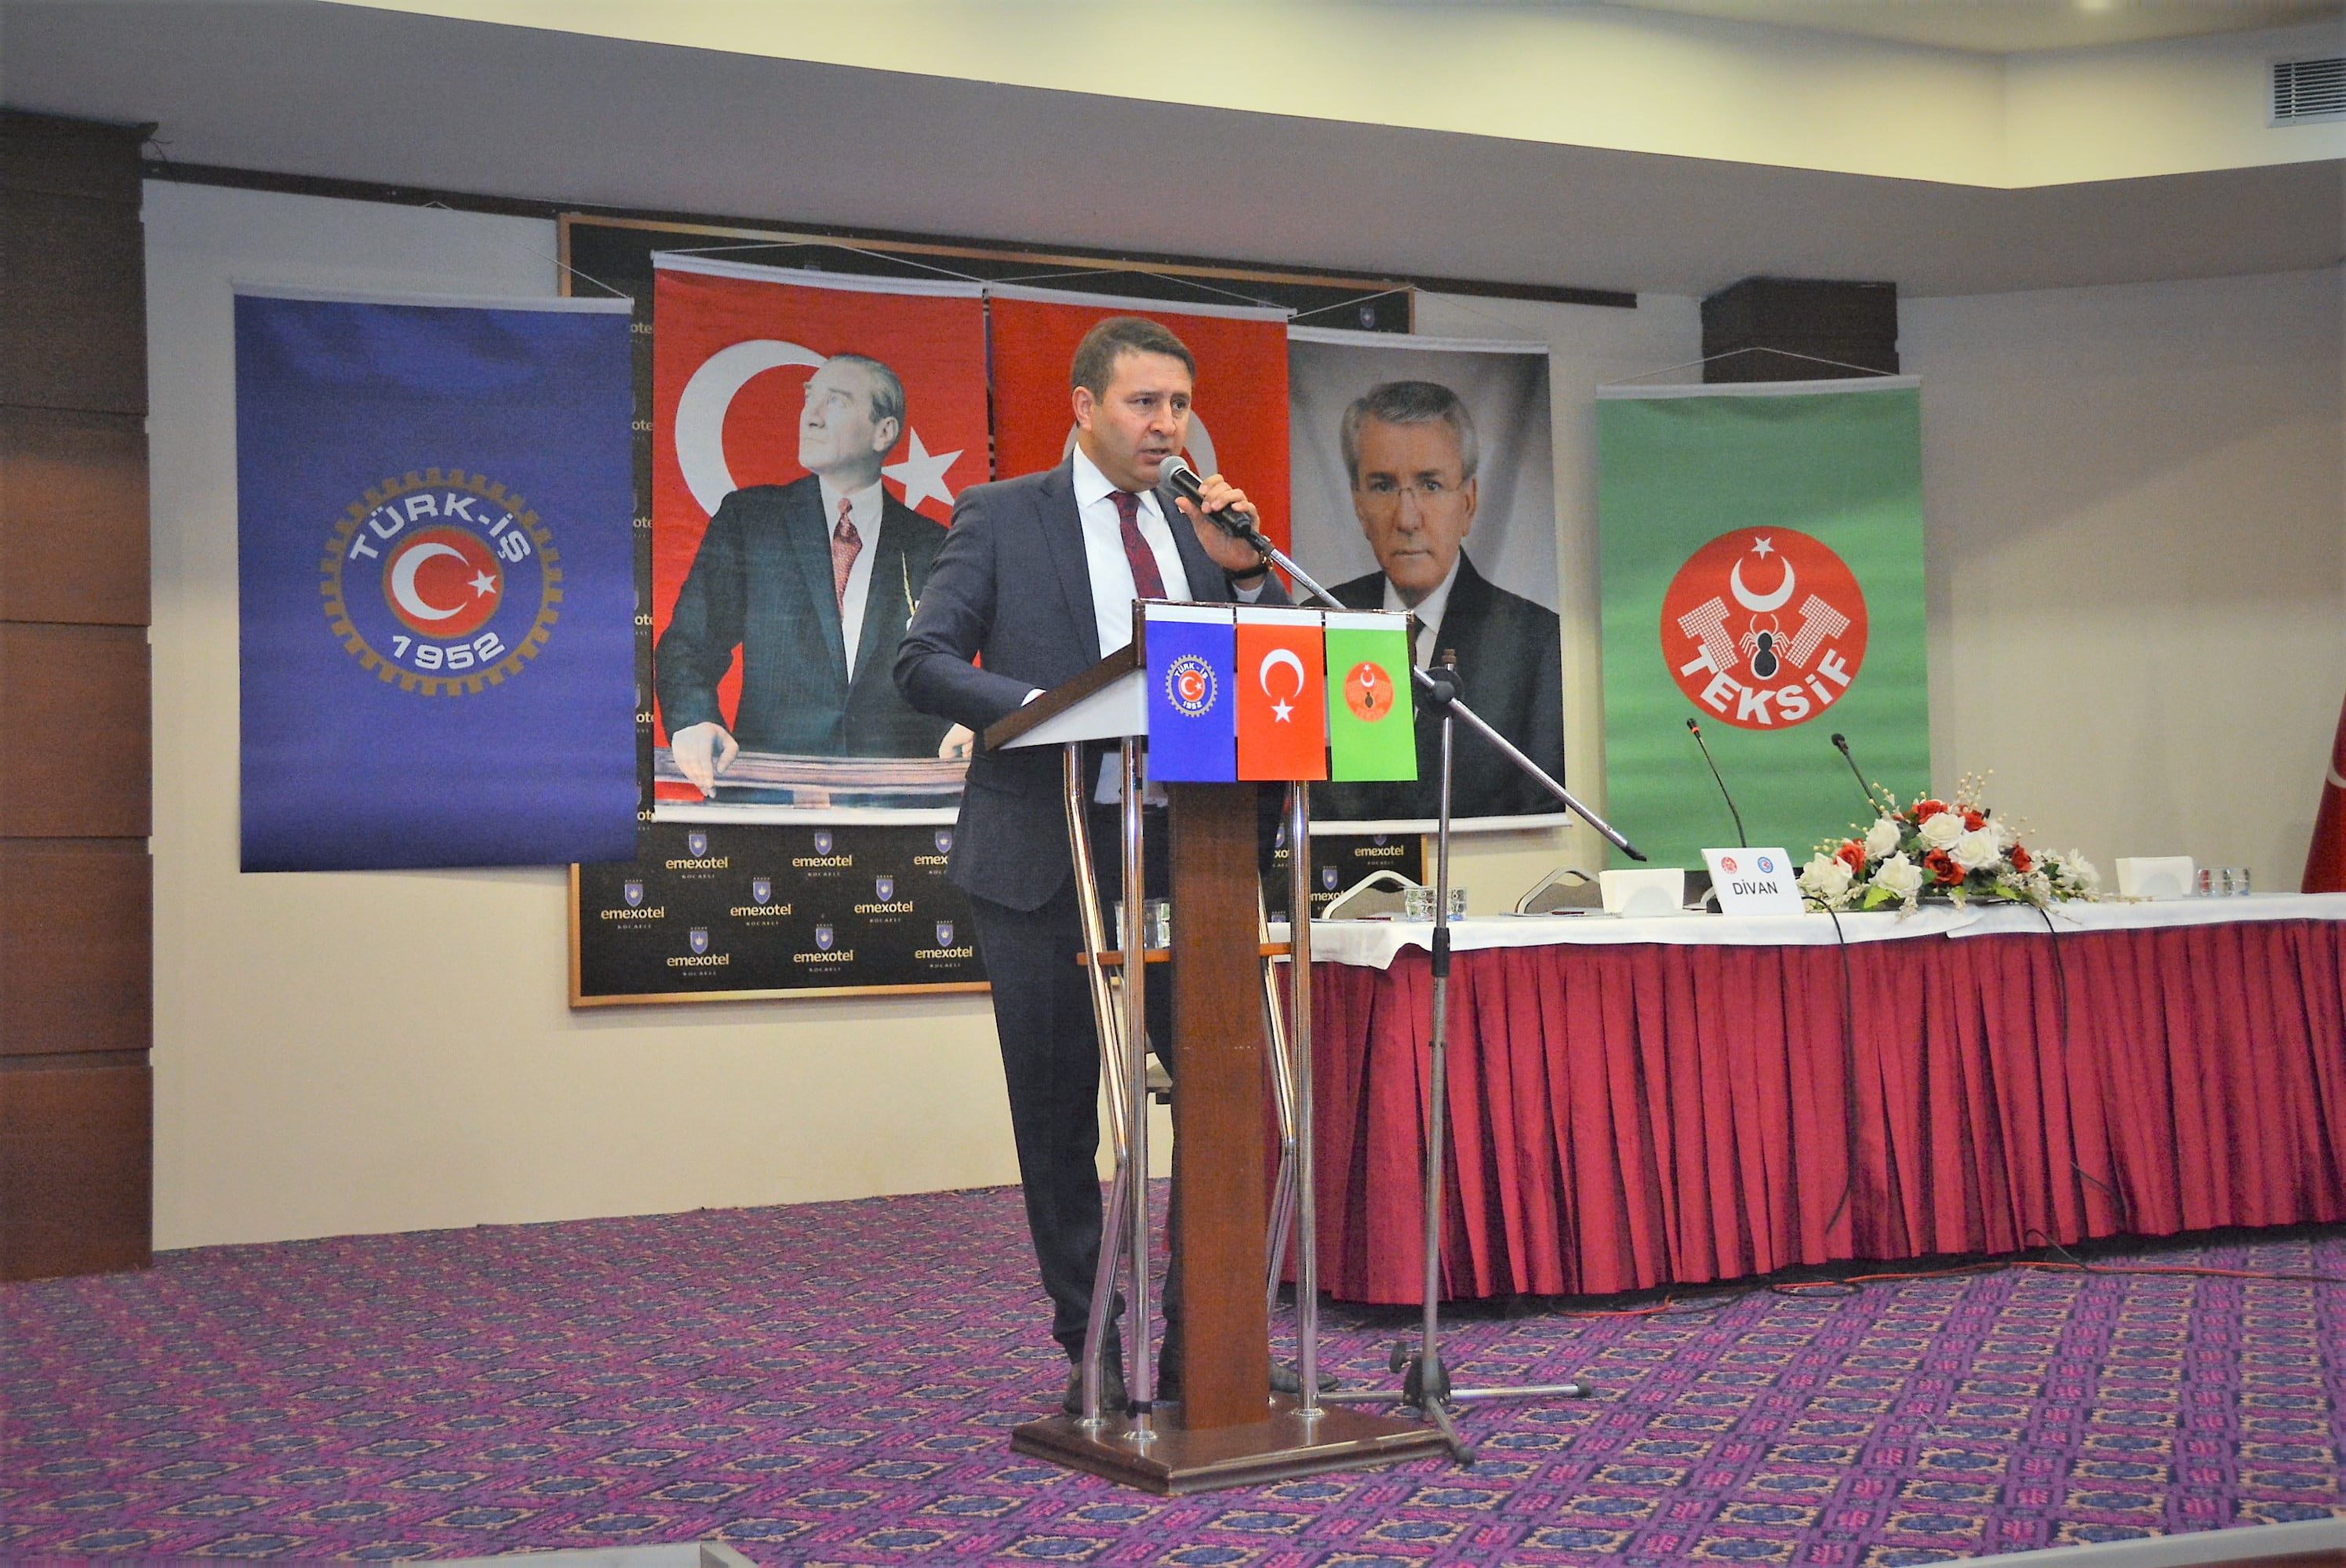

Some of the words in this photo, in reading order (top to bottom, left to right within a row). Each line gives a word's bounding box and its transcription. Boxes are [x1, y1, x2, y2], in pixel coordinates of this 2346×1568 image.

[350, 492, 532, 563] TÜRK-İŞ
[392, 631, 505, 670] 1952
[1355, 845, 1404, 857] emexotel
[665, 857, 729, 870] emexotel
[791, 854, 853, 868] emexotel
[914, 854, 948, 865] emex
[1732, 879, 1778, 895] DİVAN
[601, 906, 665, 919] emexotel
[729, 904, 791, 917] emexotel
[854, 900, 913, 914] emexotel
[793, 949, 853, 962] emexotel
[915, 945, 973, 959] emexotel
[667, 953, 729, 966] emexotel
